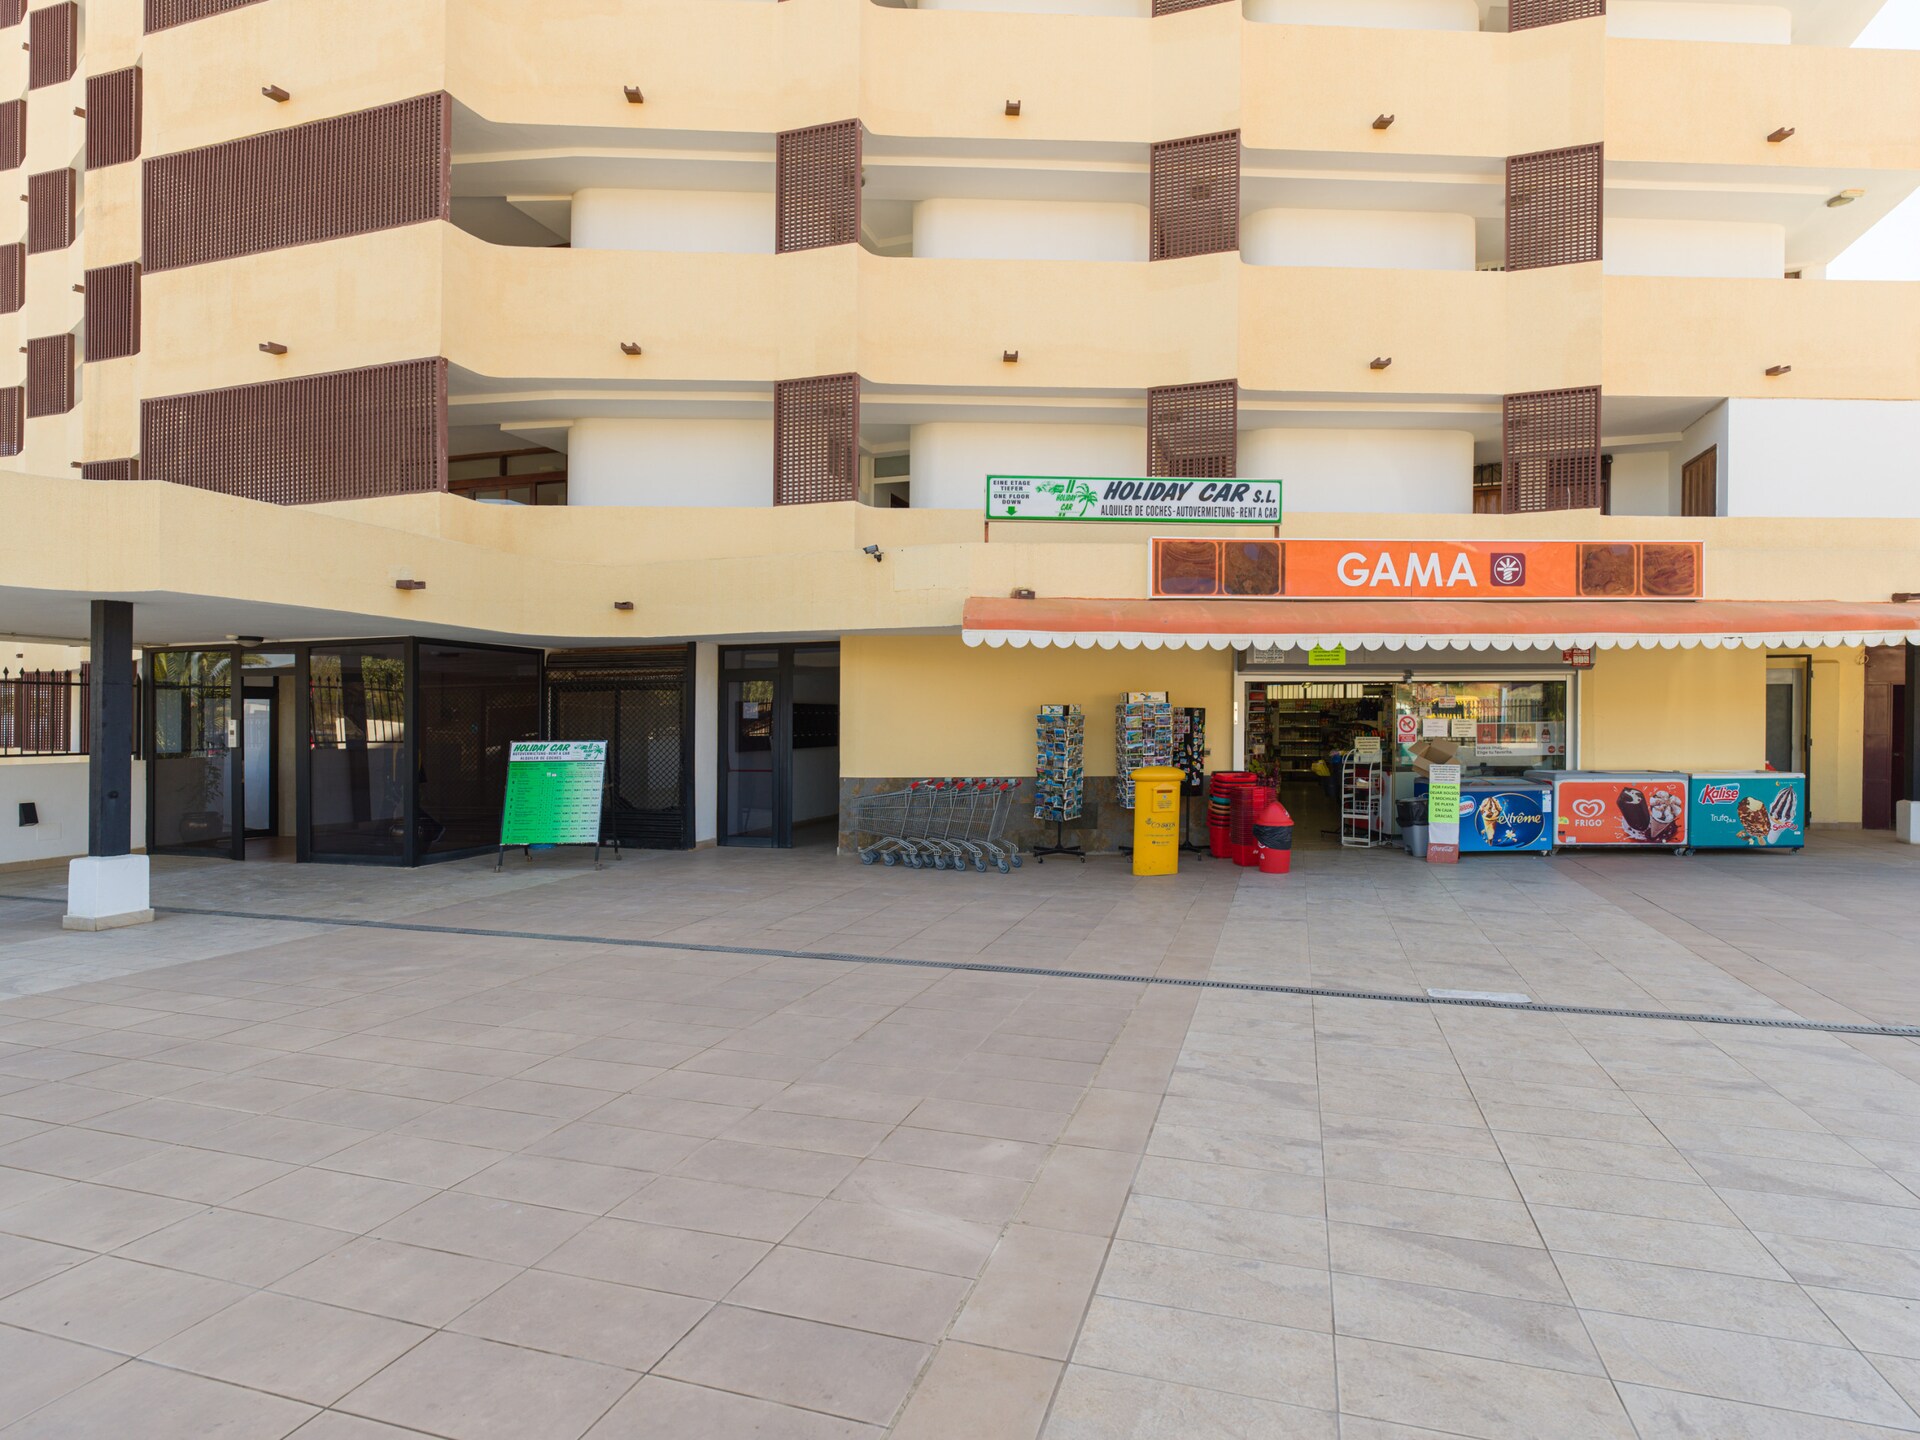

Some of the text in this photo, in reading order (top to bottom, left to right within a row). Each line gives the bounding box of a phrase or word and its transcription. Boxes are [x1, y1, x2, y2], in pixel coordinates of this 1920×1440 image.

[1103, 481, 1276, 503] HOLIDAY CAR S.L.
[1100, 505, 1132, 516] ALQUILER
[1135, 506, 1143, 516] DE
[1258, 507, 1262, 518] A
[1264, 507, 1278, 518] CAR
[1337, 552, 1478, 587] GAMA
[1702, 784, 1739, 804] Kalise
